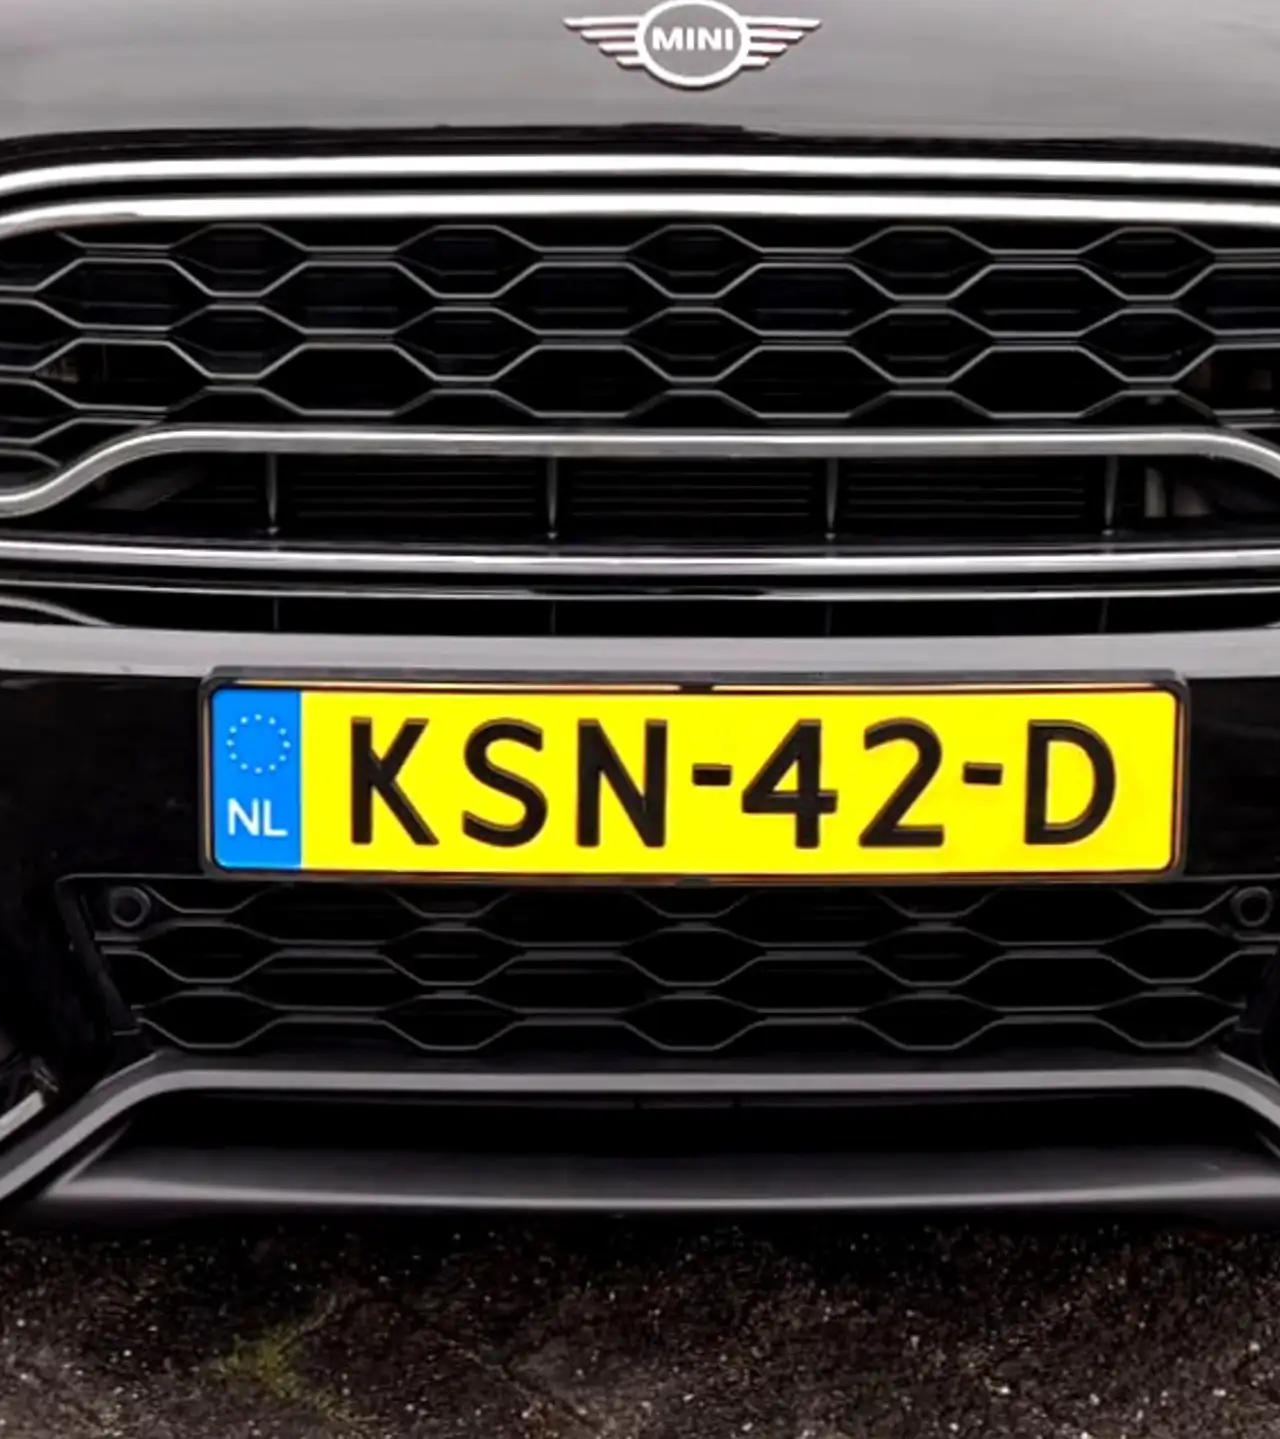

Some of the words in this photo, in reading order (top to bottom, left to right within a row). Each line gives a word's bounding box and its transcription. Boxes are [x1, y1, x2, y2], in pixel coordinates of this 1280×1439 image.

[651, 26, 734, 51] MINI
[351, 717, 1117, 849] KSN-42-D
[227, 798, 287, 837] NL
